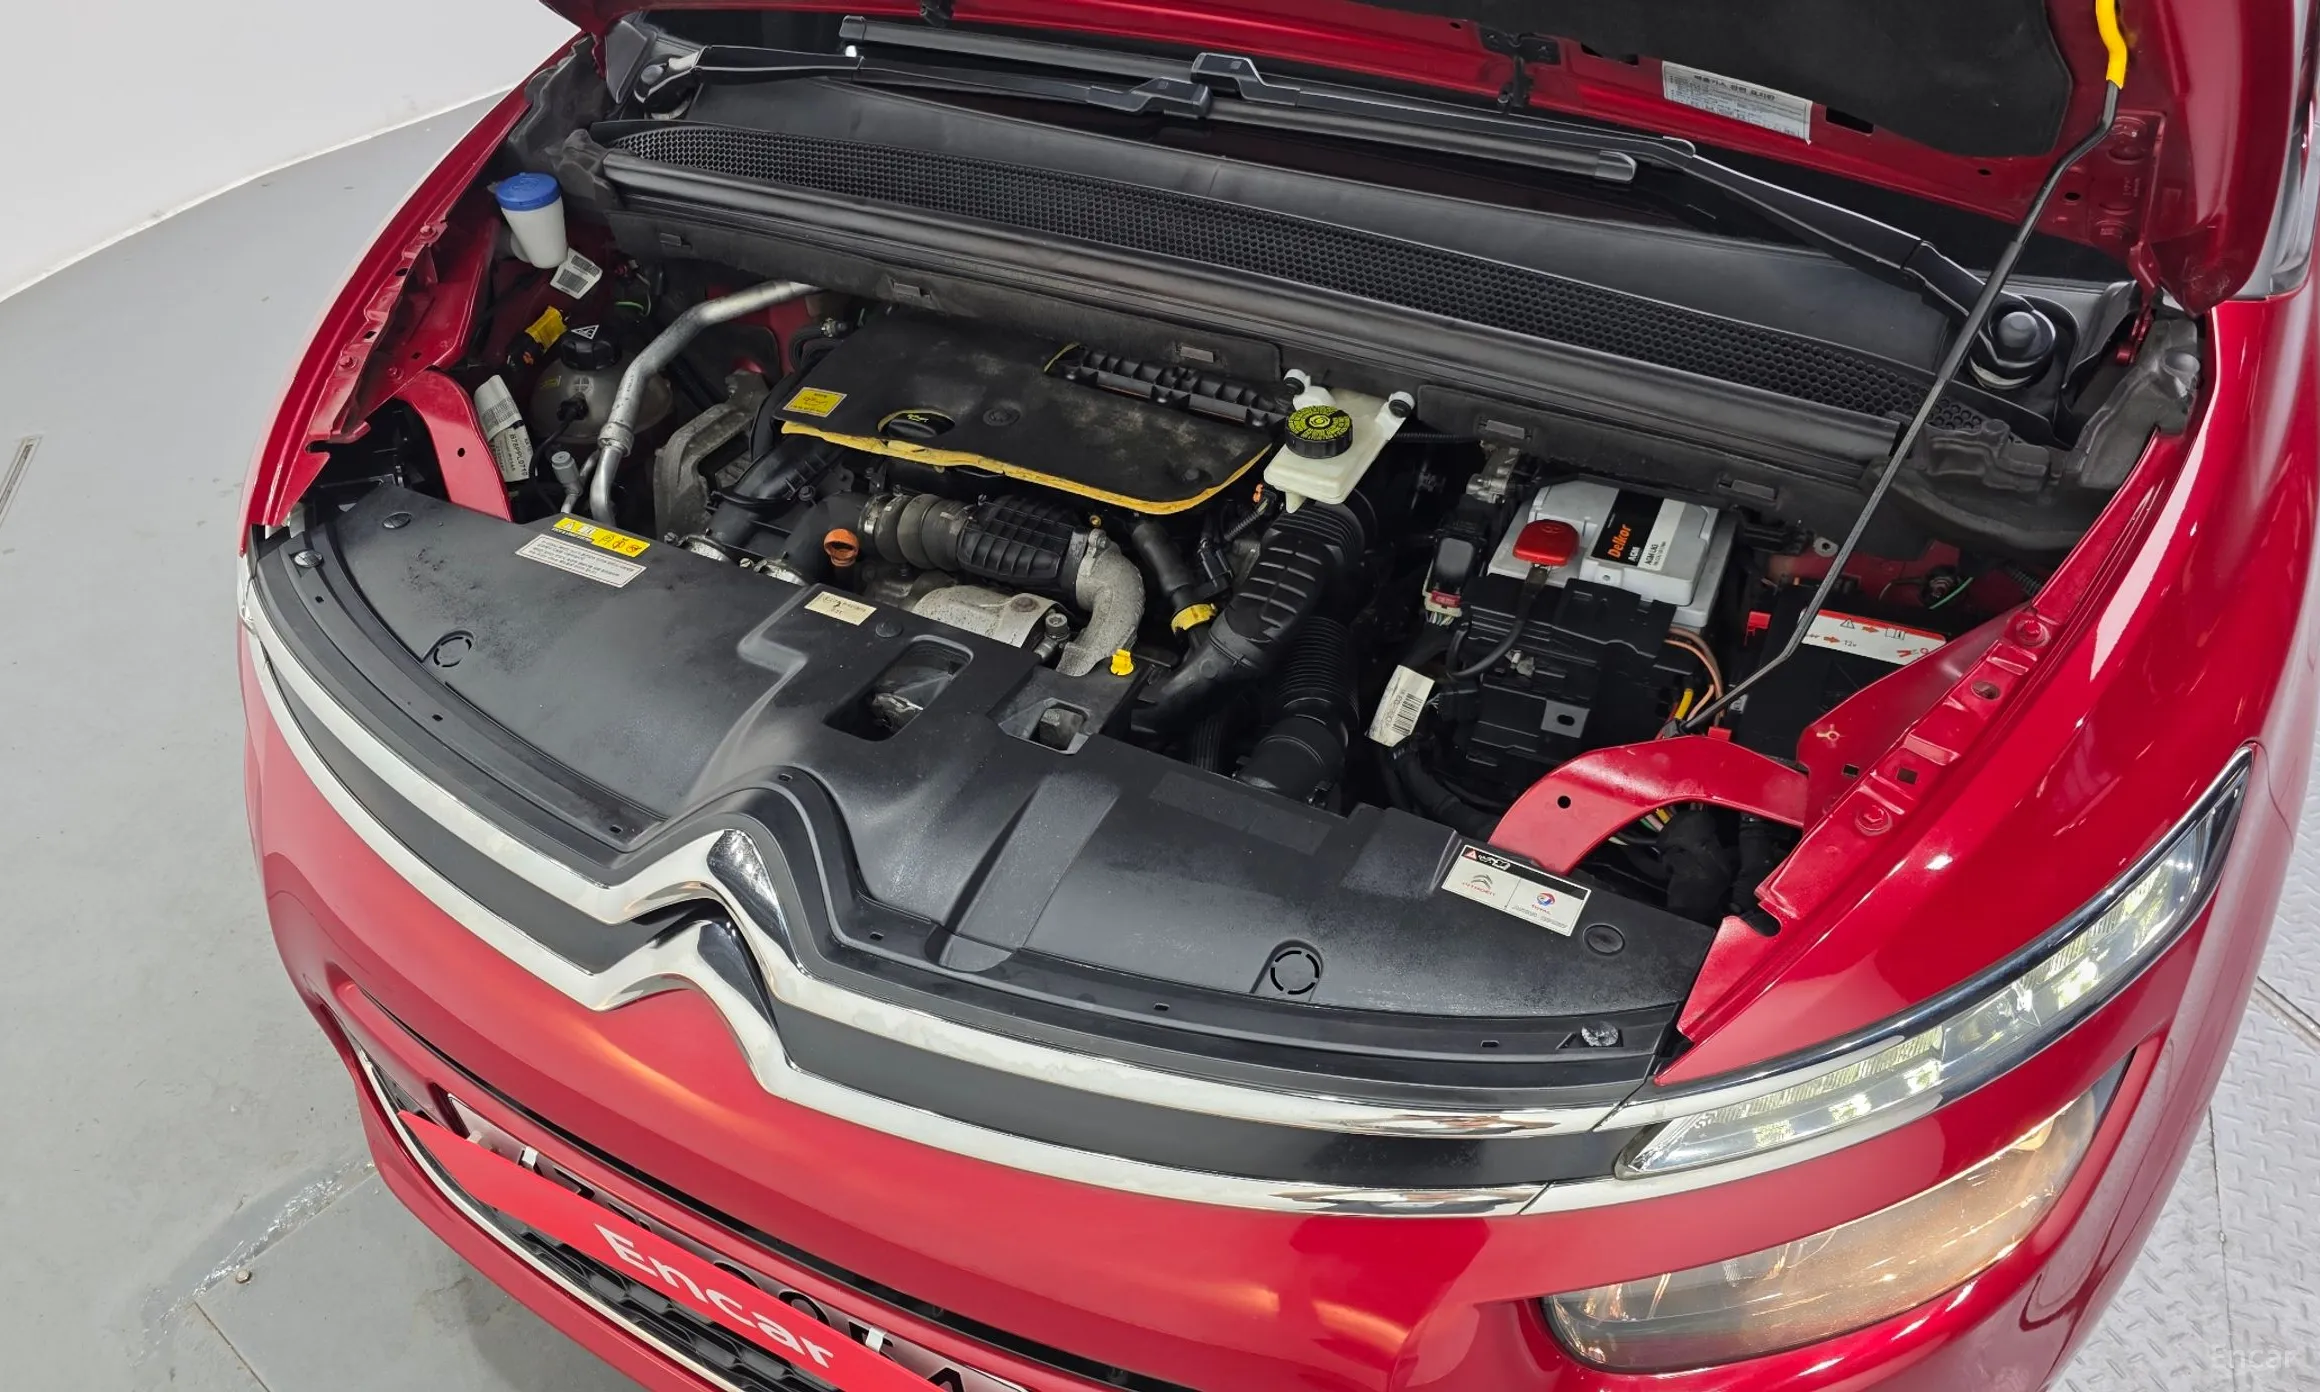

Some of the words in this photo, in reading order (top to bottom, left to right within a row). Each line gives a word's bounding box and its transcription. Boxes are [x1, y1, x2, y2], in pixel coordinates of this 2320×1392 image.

[1607, 523, 1632, 558] Delkor
[1627, 546, 1642, 562] AGM
[593, 1222, 836, 1369] Encar
